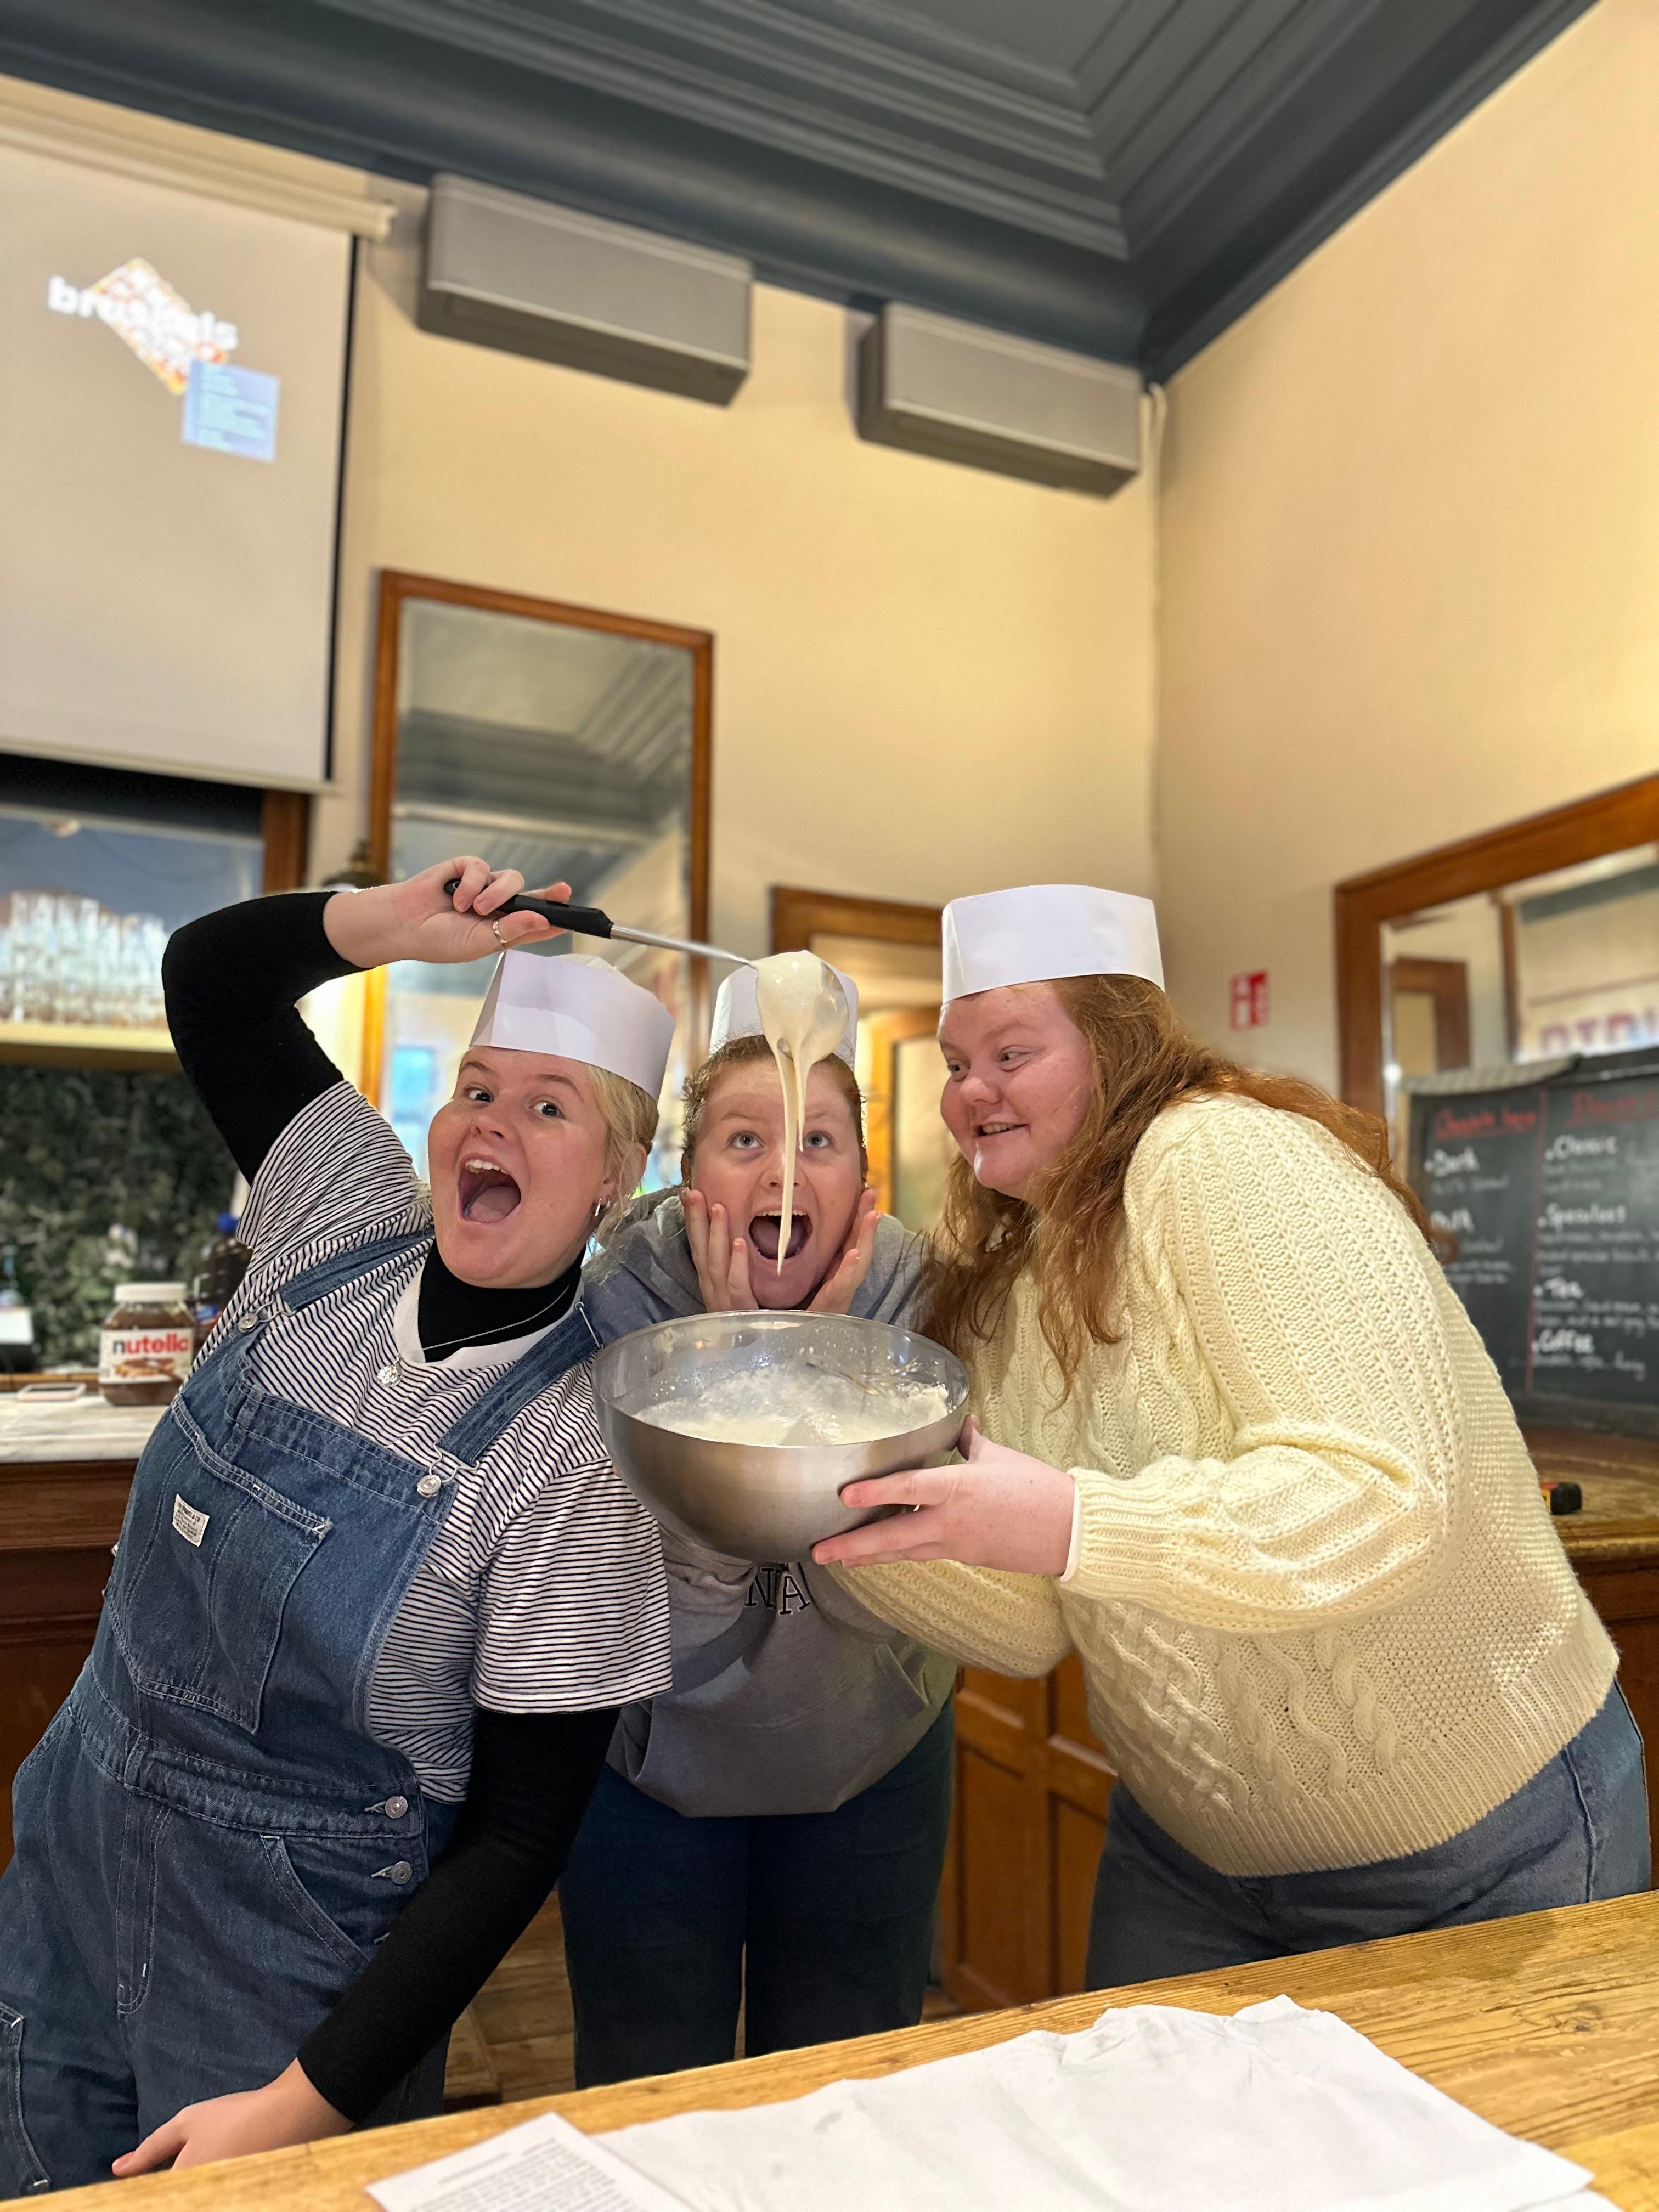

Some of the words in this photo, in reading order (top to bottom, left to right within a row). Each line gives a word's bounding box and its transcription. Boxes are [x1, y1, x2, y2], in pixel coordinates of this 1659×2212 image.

[1553, 1135, 1617, 1159] Classic
[1433, 1147, 1480, 1177] Dark
[1544, 1277, 1584, 1299] Tea
[113, 1333, 190, 1355] nutella
[1539, 1329, 1595, 1354] Coffee
